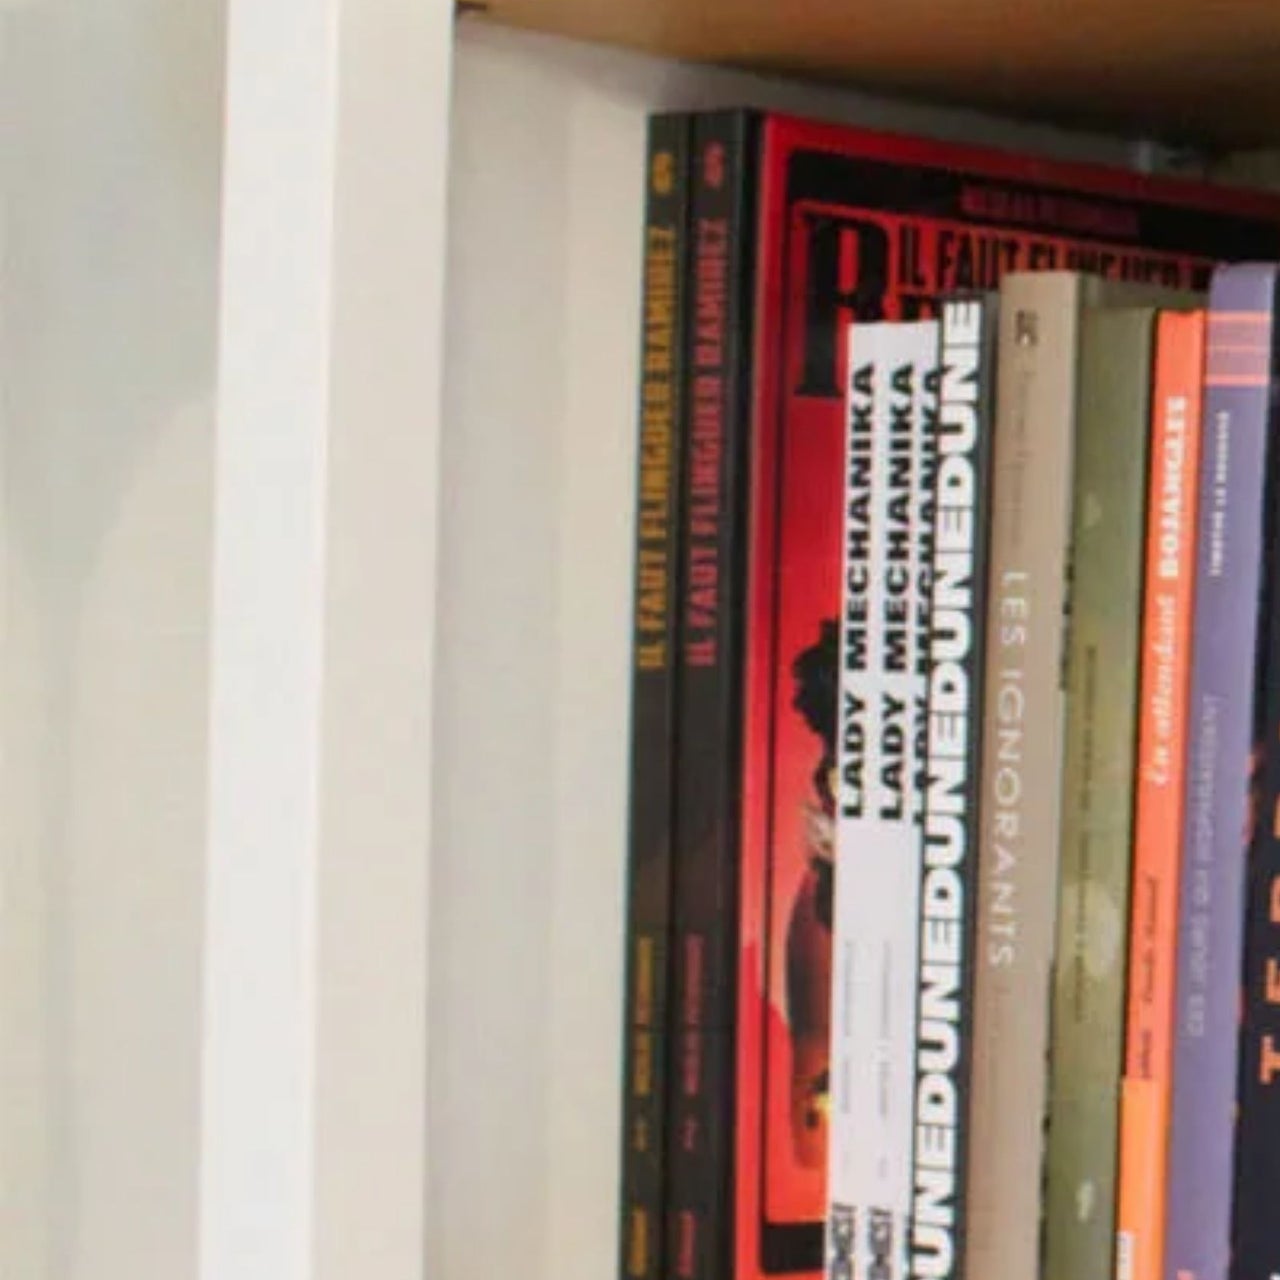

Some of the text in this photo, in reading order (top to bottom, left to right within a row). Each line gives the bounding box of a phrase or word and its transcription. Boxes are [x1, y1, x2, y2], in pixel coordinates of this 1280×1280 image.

[638, 373, 674, 537] FLINGUER
[687, 376, 722, 536] FLINGUER
[637, 538, 668, 631] FAUT
[686, 546, 718, 630] FAUT
[842, 361, 874, 819] LADY MECHANIKA
[882, 361, 914, 821] LADY MECHANIKA
[1003, 570, 1028, 646] LES
[637, 641, 664, 668] IL
[686, 641, 714, 665] IL
[987, 670, 1023, 968] IGNORANTS
